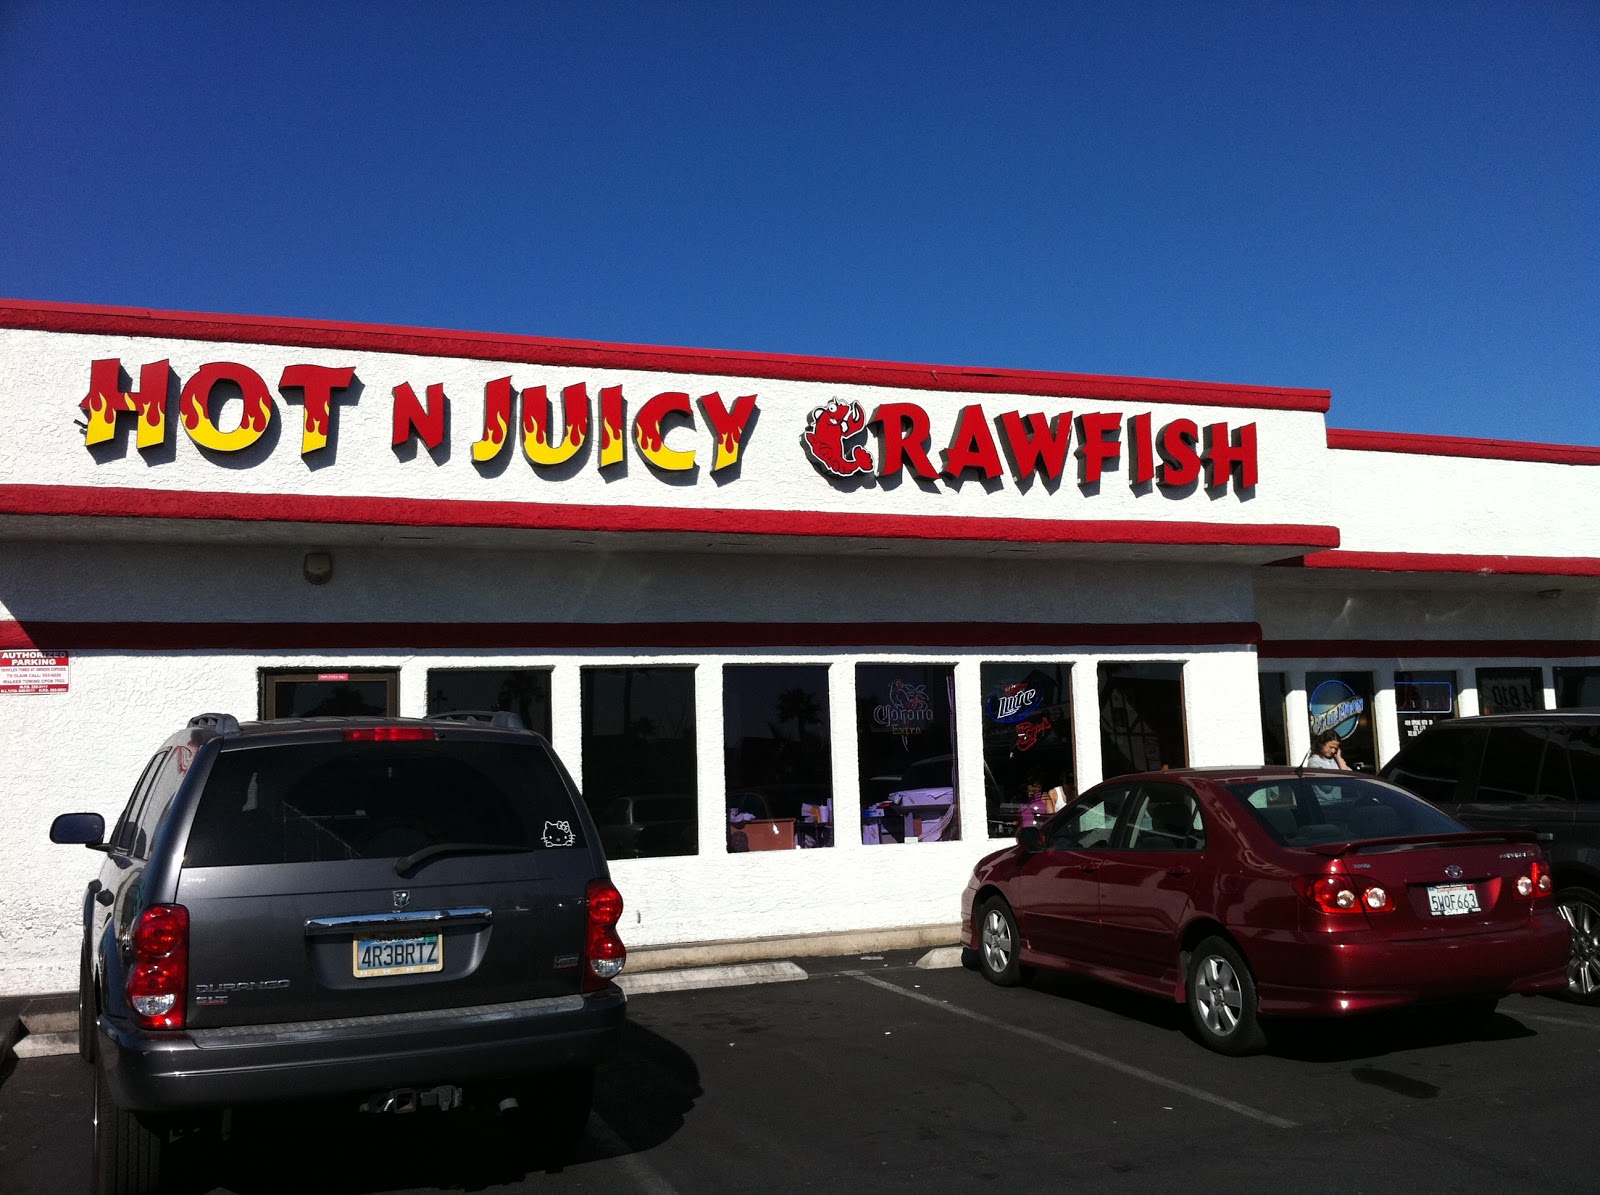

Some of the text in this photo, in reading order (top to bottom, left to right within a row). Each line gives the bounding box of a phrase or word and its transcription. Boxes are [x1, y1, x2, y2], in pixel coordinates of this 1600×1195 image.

[79, 357, 357, 455] HOT
[391, 380, 445, 450] N
[471, 375, 758, 472] JUICY
[2, 651, 66, 659] AUTHORIZED
[11, 658, 57, 666] PARKING
[872, 703, 934, 727] Corona
[891, 723, 922, 735] Extra
[361, 941, 438, 968] 4R3BRTZ
